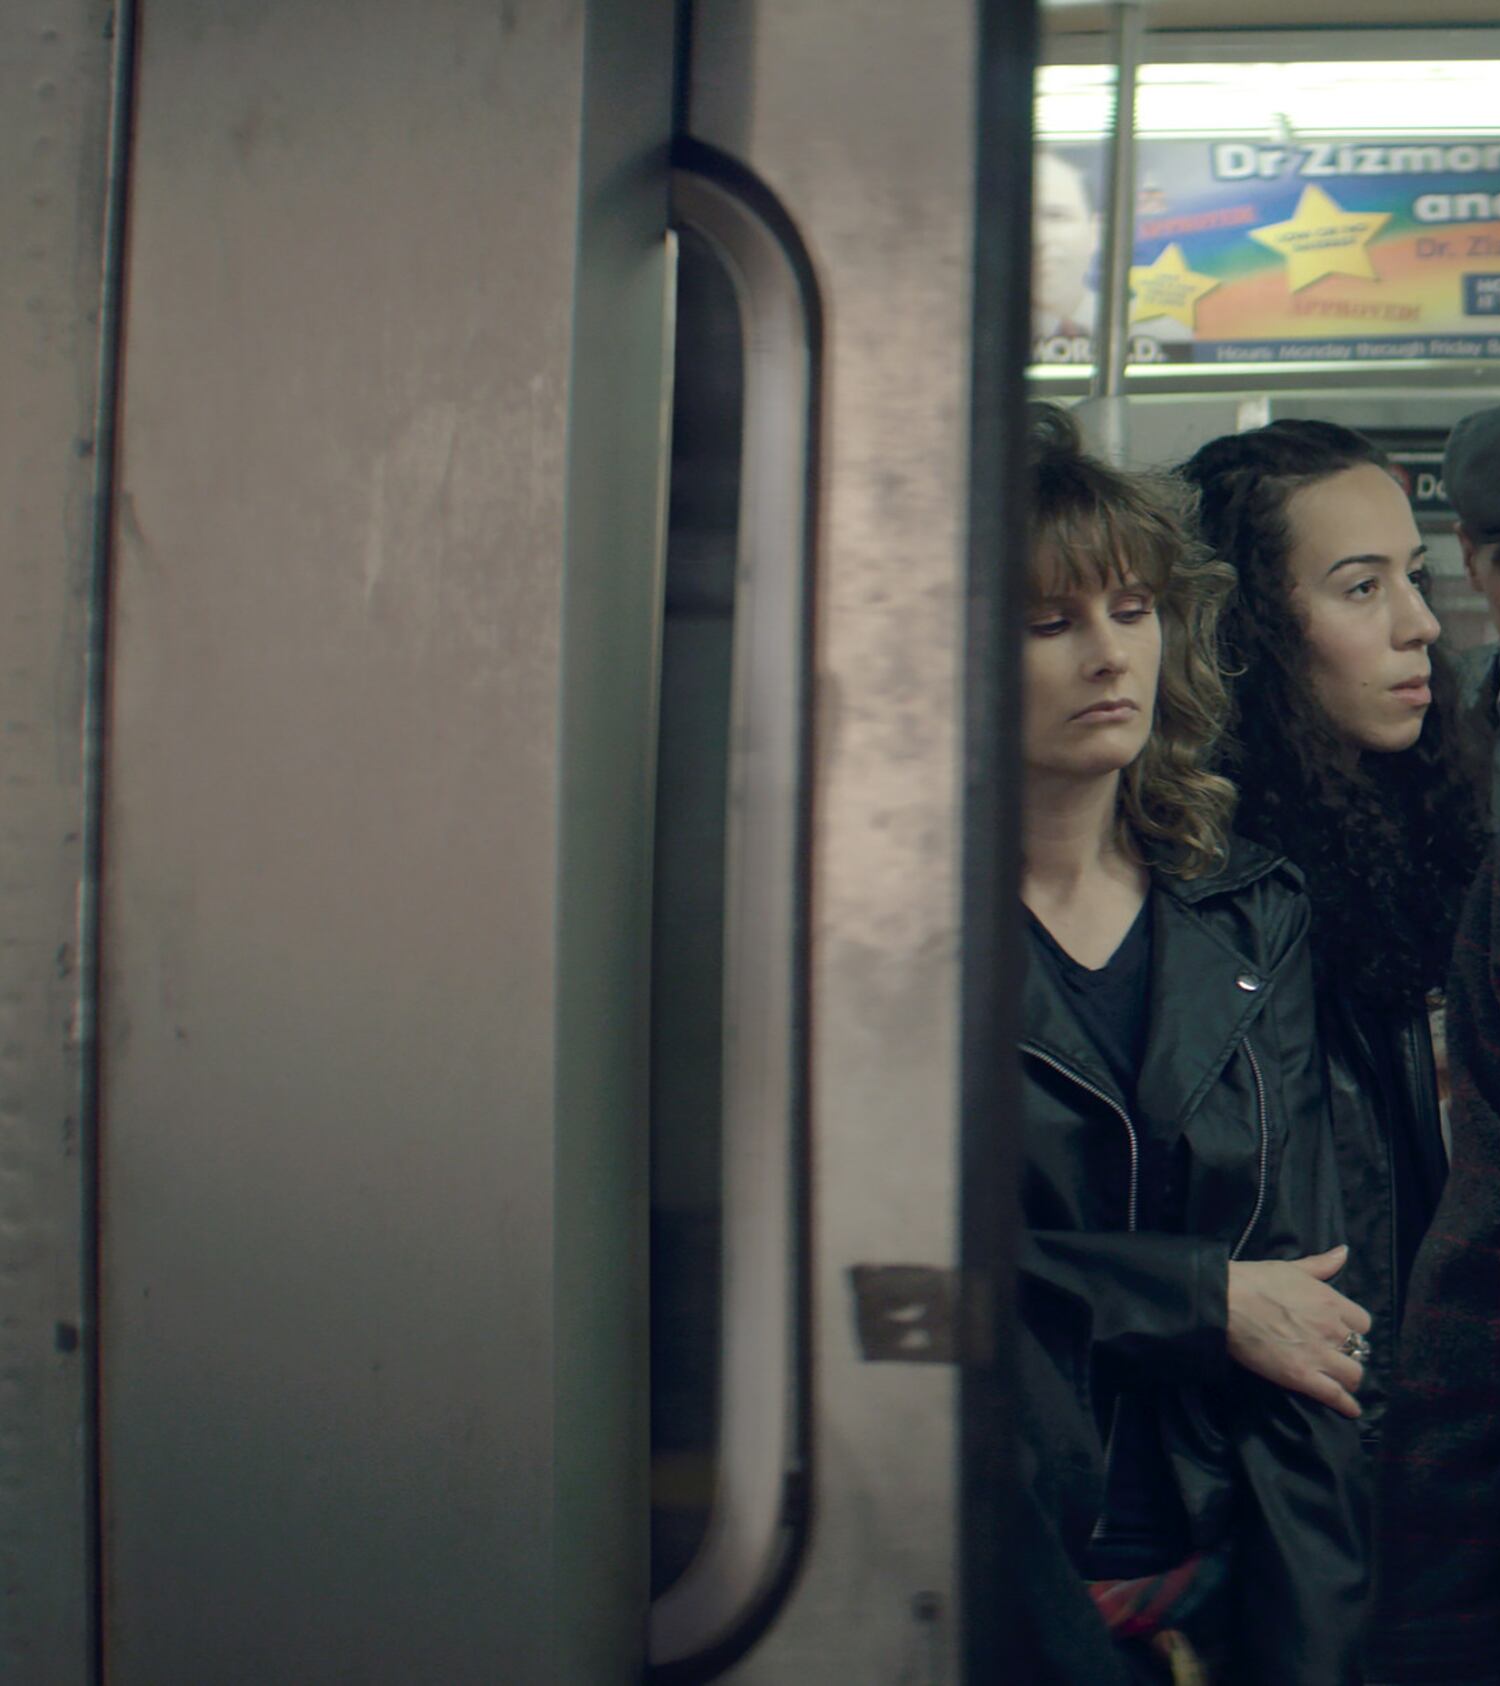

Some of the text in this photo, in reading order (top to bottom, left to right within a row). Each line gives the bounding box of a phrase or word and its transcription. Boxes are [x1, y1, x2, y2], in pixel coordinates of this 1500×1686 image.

[1214, 143, 1284, 178] Dr
[1279, 342, 1352, 361] Monday
[1356, 339, 1425, 359] through
[1429, 339, 1483, 358] Friday
